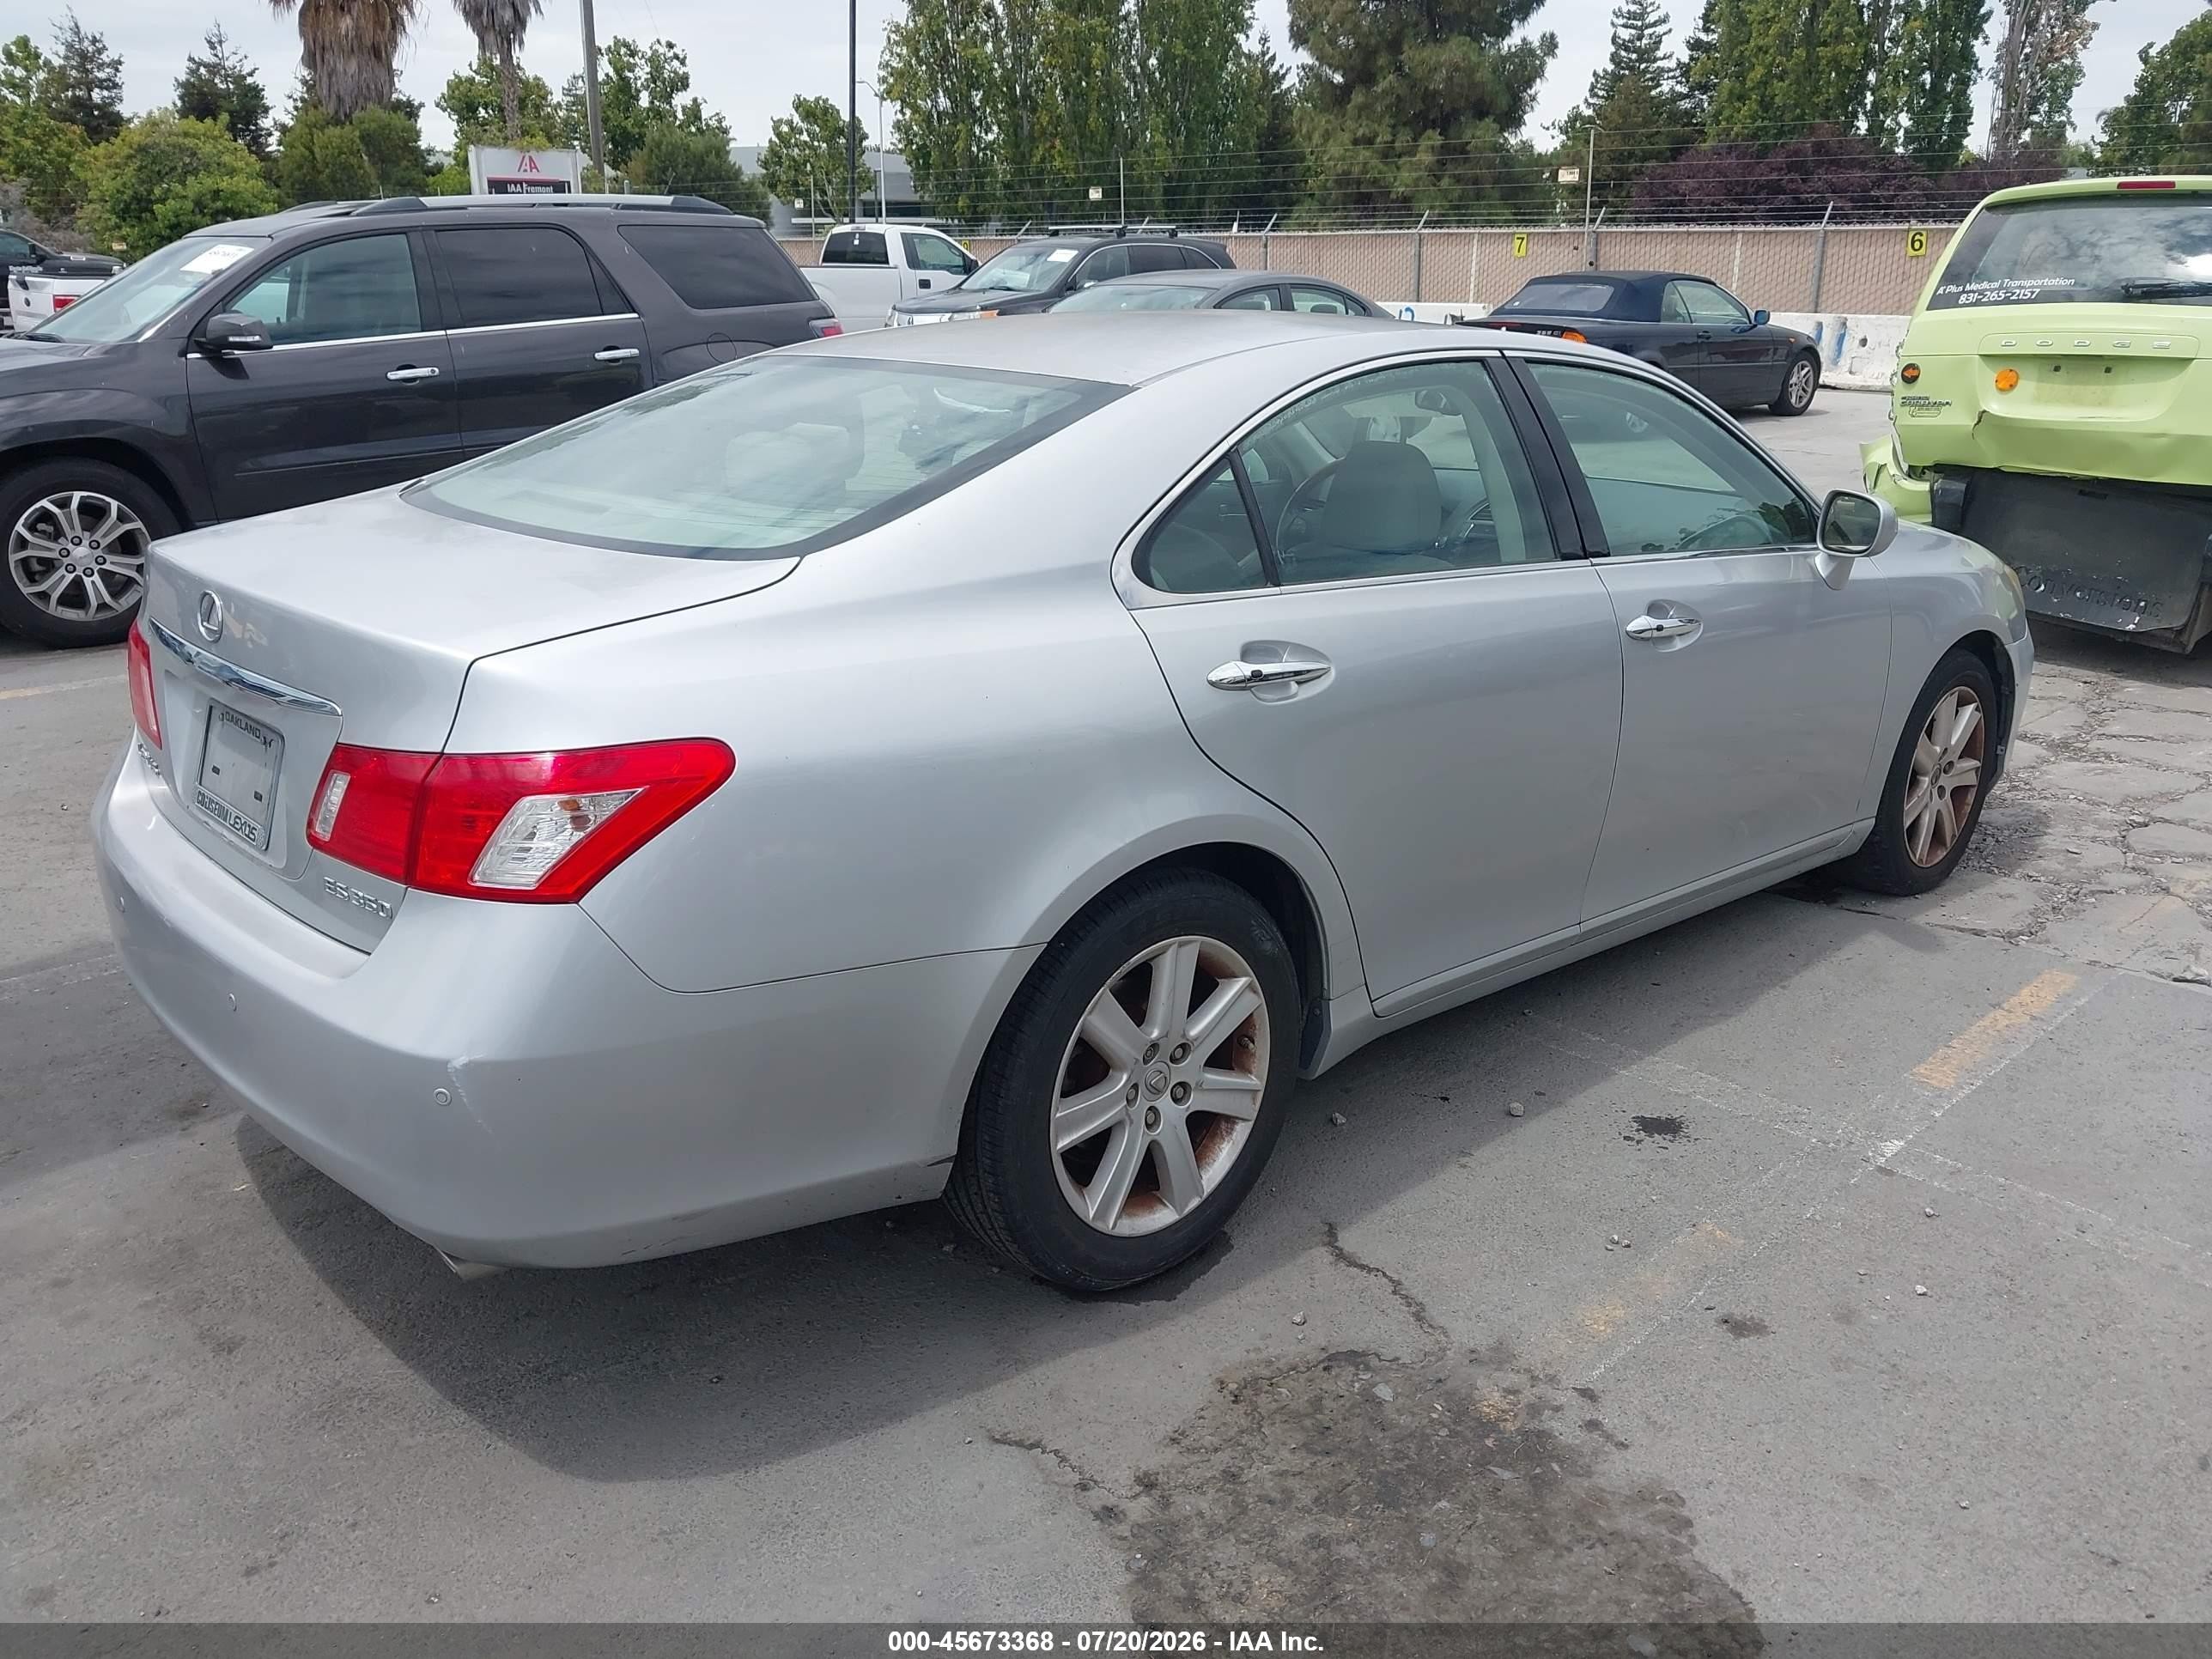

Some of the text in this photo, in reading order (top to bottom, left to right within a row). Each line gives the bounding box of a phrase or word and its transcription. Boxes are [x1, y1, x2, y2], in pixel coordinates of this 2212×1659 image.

[507, 183, 554, 194] IAA Fremont
[1516, 236, 1526, 254] 7
[1910, 232, 1924, 252] 6
[1945, 283, 1964, 294] Plus
[1965, 280, 2001, 291] Medical
[2003, 277, 2075, 289] Transportation
[1958, 289, 2041, 305] 831-265-2157
[2001, 338, 2172, 349] DODGE
[225, 711, 261, 739] OAKLAND
[228, 811, 258, 843] LEXUS
[323, 876, 350, 901] ES
